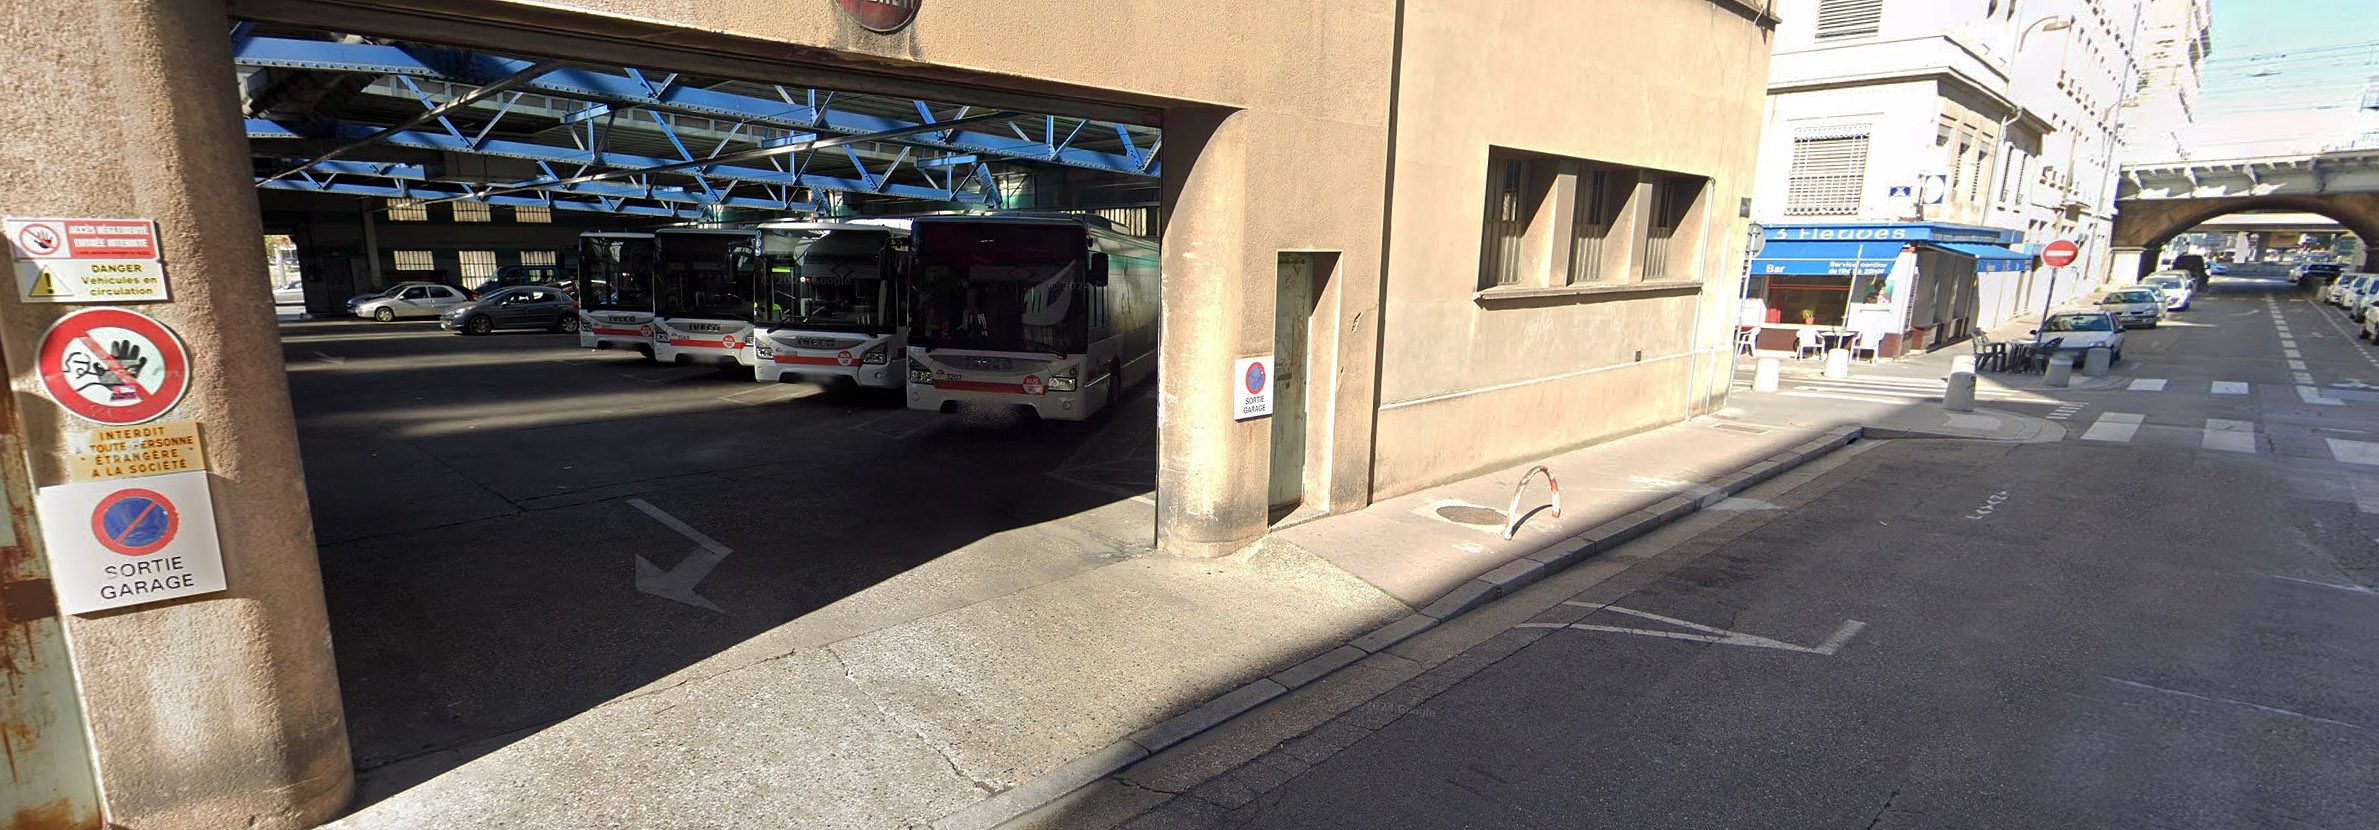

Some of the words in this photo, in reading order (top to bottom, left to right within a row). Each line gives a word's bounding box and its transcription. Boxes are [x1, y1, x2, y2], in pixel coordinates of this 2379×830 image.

[91, 264, 143, 273] DANGER
[1766, 264, 1786, 274] Bar
[90, 288, 153, 296] circulation
[608, 315, 636, 323] IVECO
[688, 323, 721, 332] IVECO
[1245, 395, 1265, 405] SORTIE
[1243, 404, 1266, 414] GARAGE
[99, 427, 165, 440] INTERDIT
[89, 442, 127, 453] TOUTE
[106, 466, 123, 476] LA
[105, 556, 184, 580] SORTIE
[100, 573, 195, 600] GARAGE
